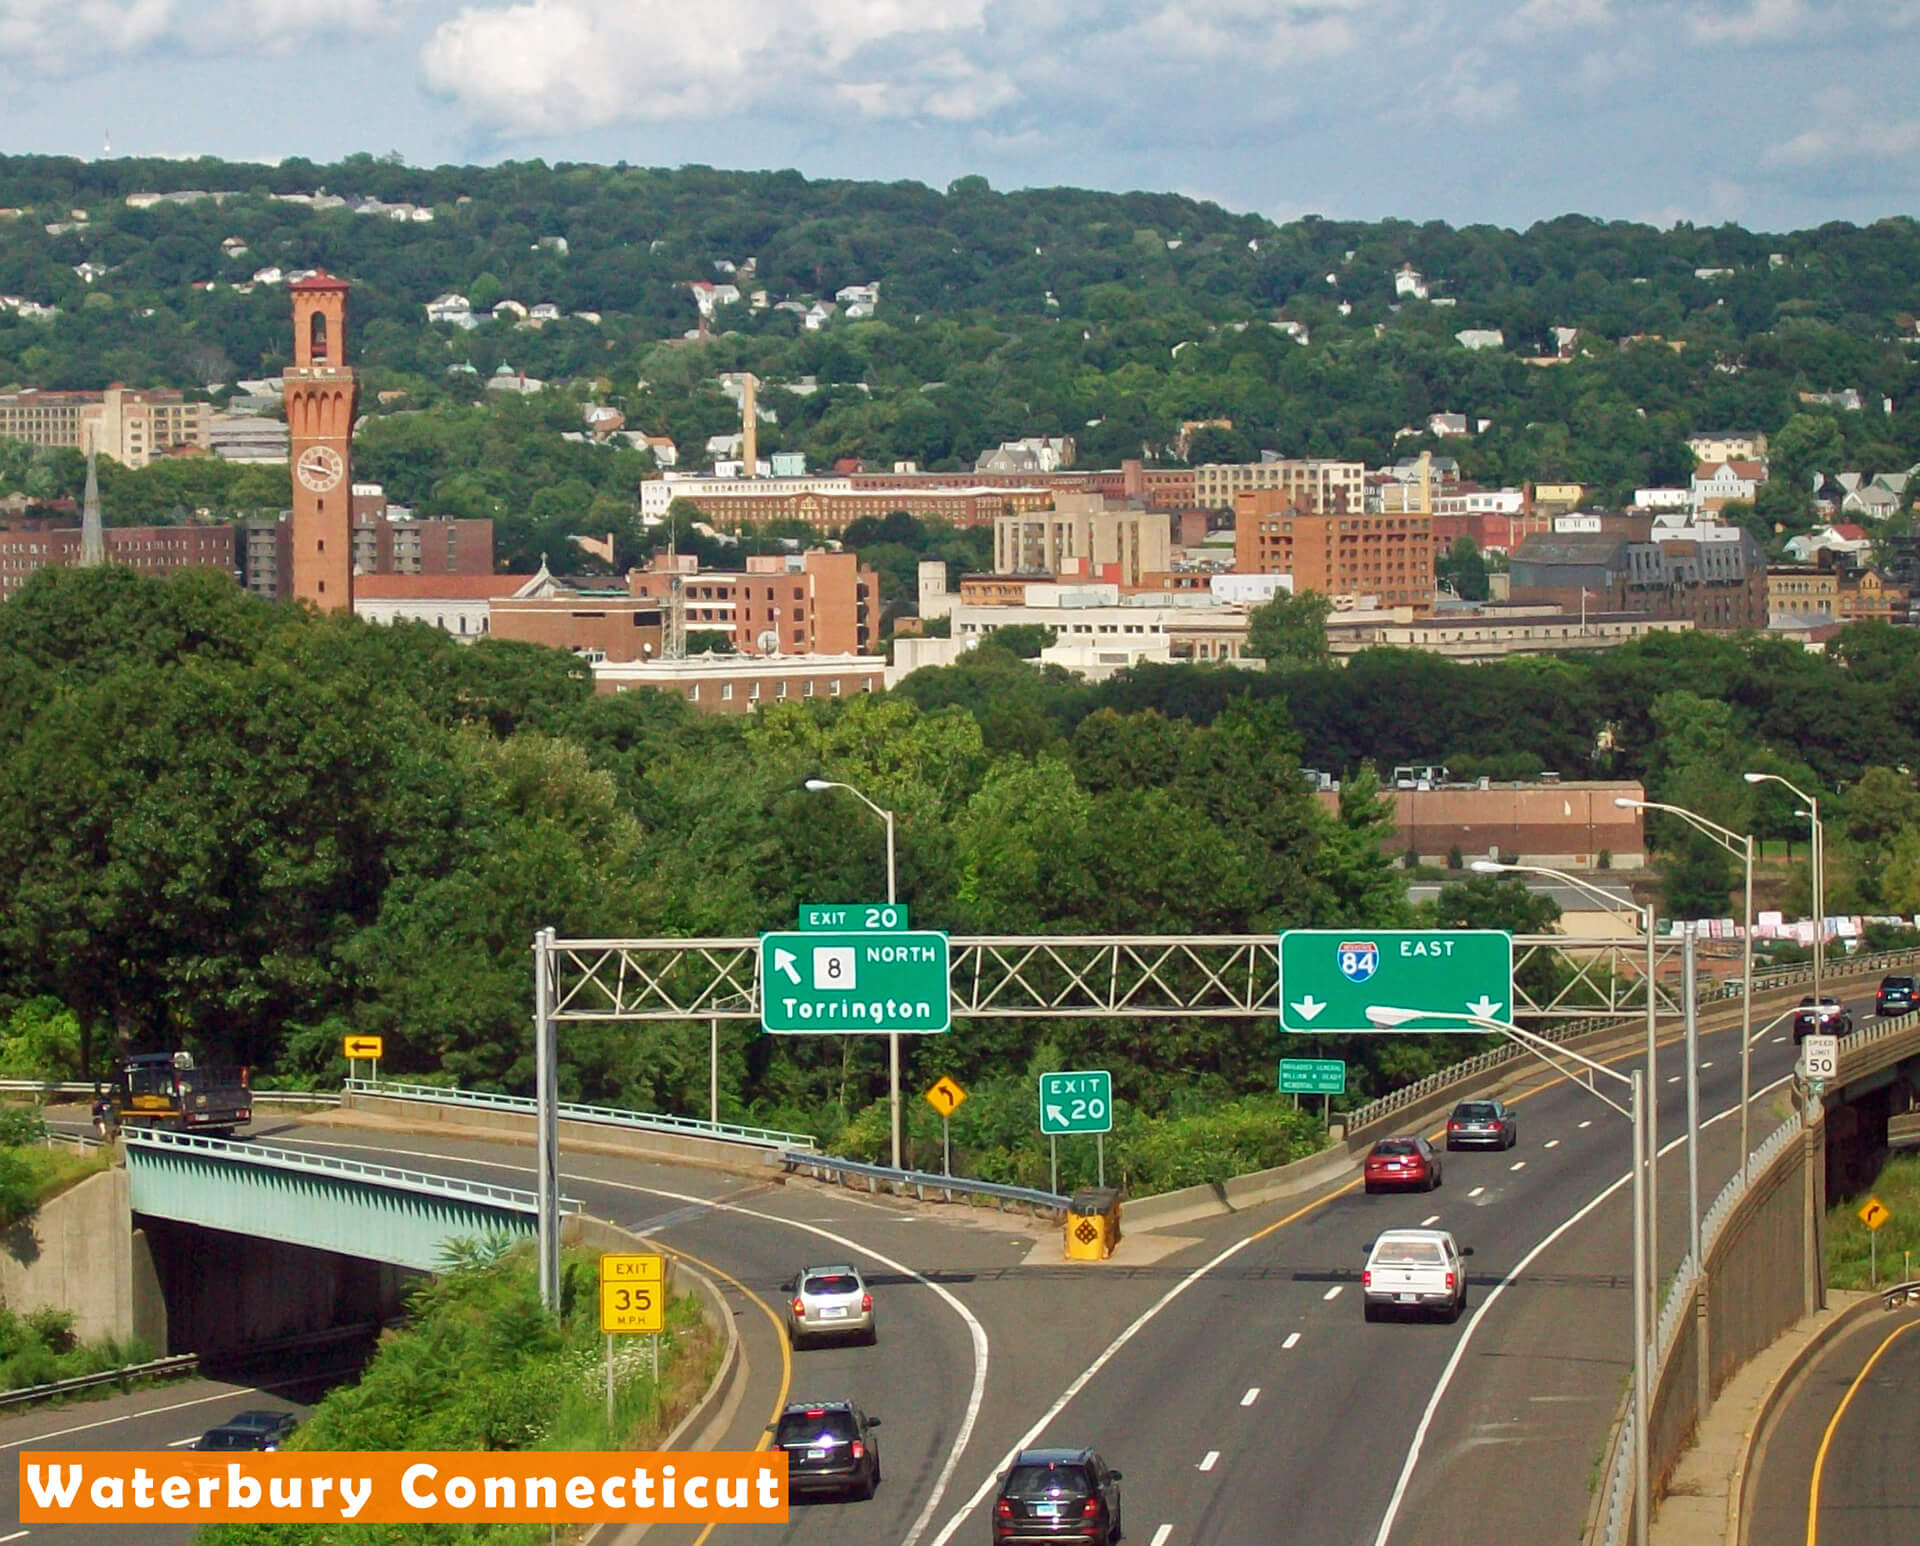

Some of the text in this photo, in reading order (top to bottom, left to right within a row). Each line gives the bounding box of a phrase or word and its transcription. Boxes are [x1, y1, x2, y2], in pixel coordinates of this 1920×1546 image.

[809, 908, 898, 928] EXIT 20
[866, 946, 936, 963] NORTH
[1400, 940, 1455, 957] EAST
[827, 957, 842, 979] 8
[1342, 952, 1374, 975] 84
[782, 998, 931, 1025] Torrington
[1808, 1039, 1834, 1047] SPEED
[1809, 1058, 1832, 1072] 50
[1050, 1079, 1100, 1095] EXIT
[1071, 1098, 1105, 1119] 20
[616, 1262, 649, 1275] EXIT
[614, 1288, 652, 1311] 35
[617, 1315, 647, 1325] MPH
